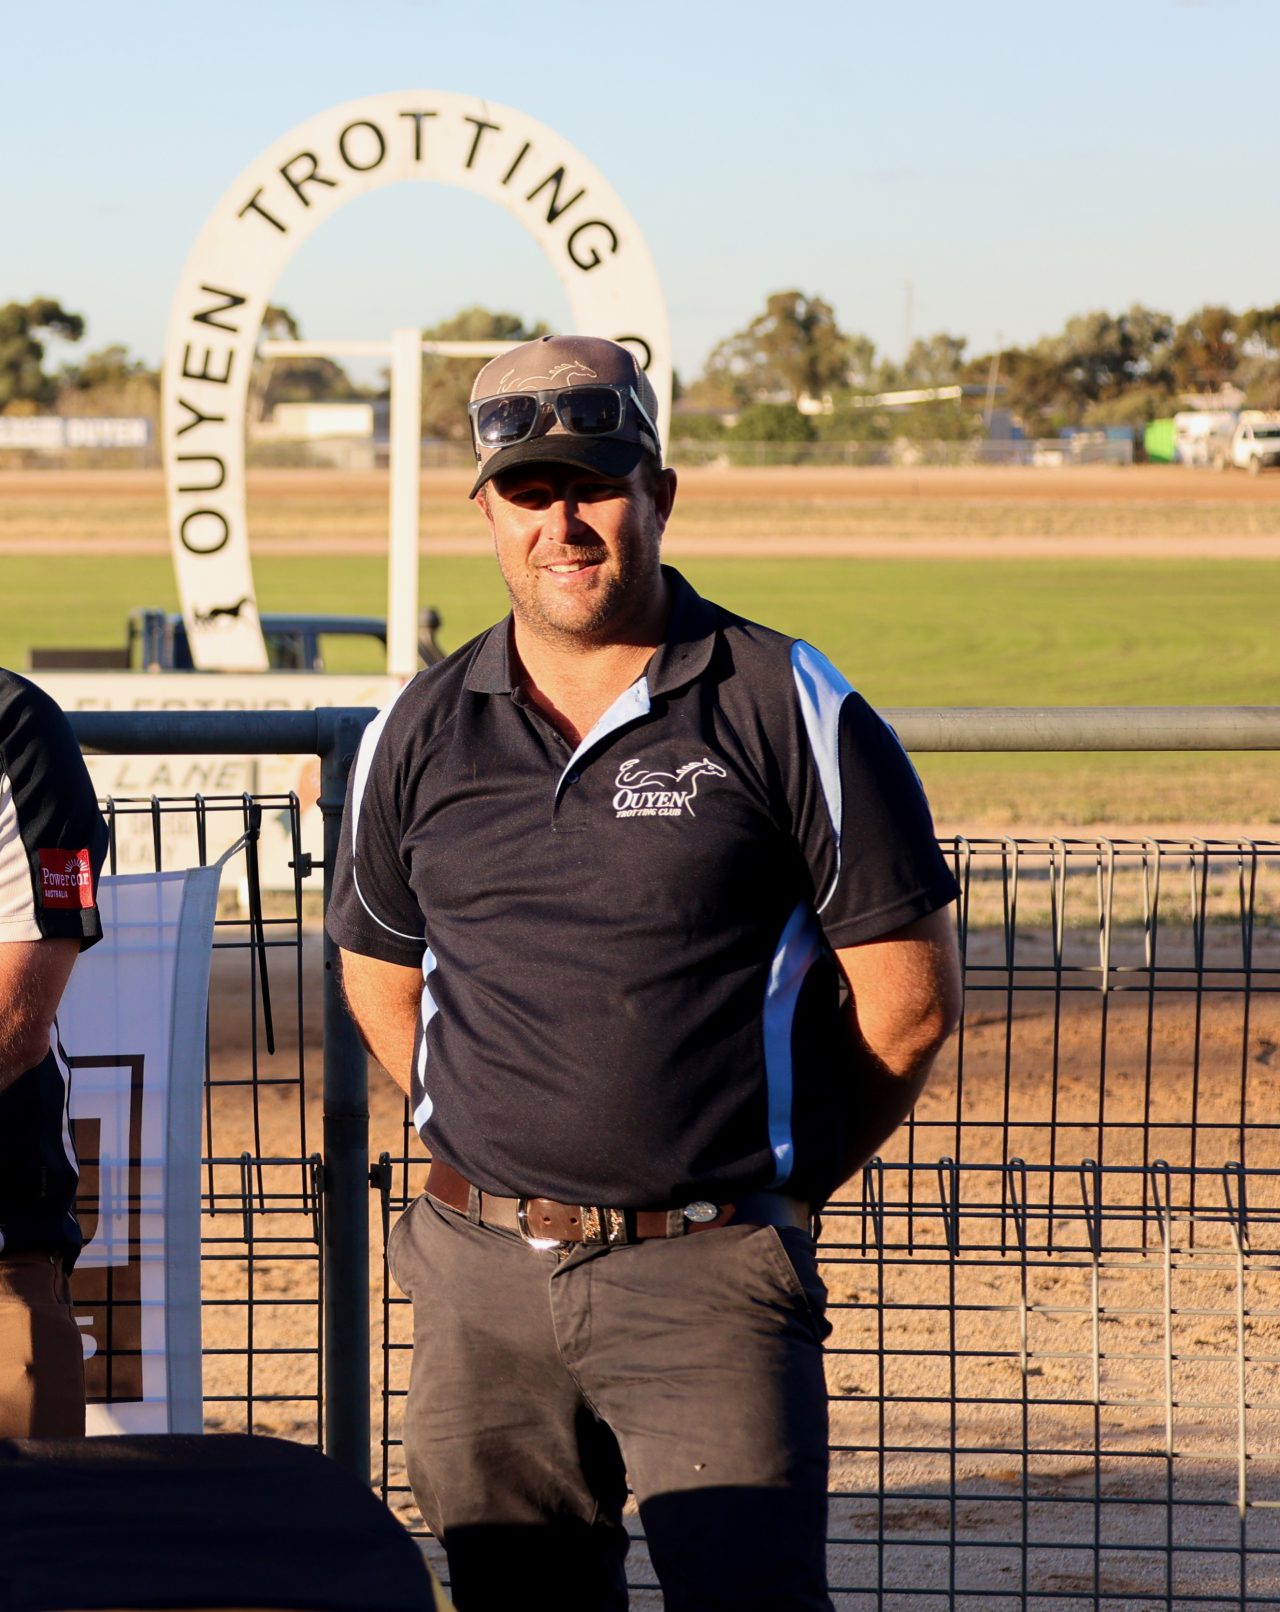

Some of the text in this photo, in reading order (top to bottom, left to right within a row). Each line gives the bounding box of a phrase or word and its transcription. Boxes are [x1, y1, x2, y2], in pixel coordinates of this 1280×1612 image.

[177, 283, 248, 556] OUYEN
[237, 110, 621, 272] TROTTING
[612, 788, 687, 810] OUYEN
[615, 807, 682, 818] TROTTING CLUB
[42, 867, 90, 887] Powercor
[44, 889, 69, 899] AUSTRALIA
